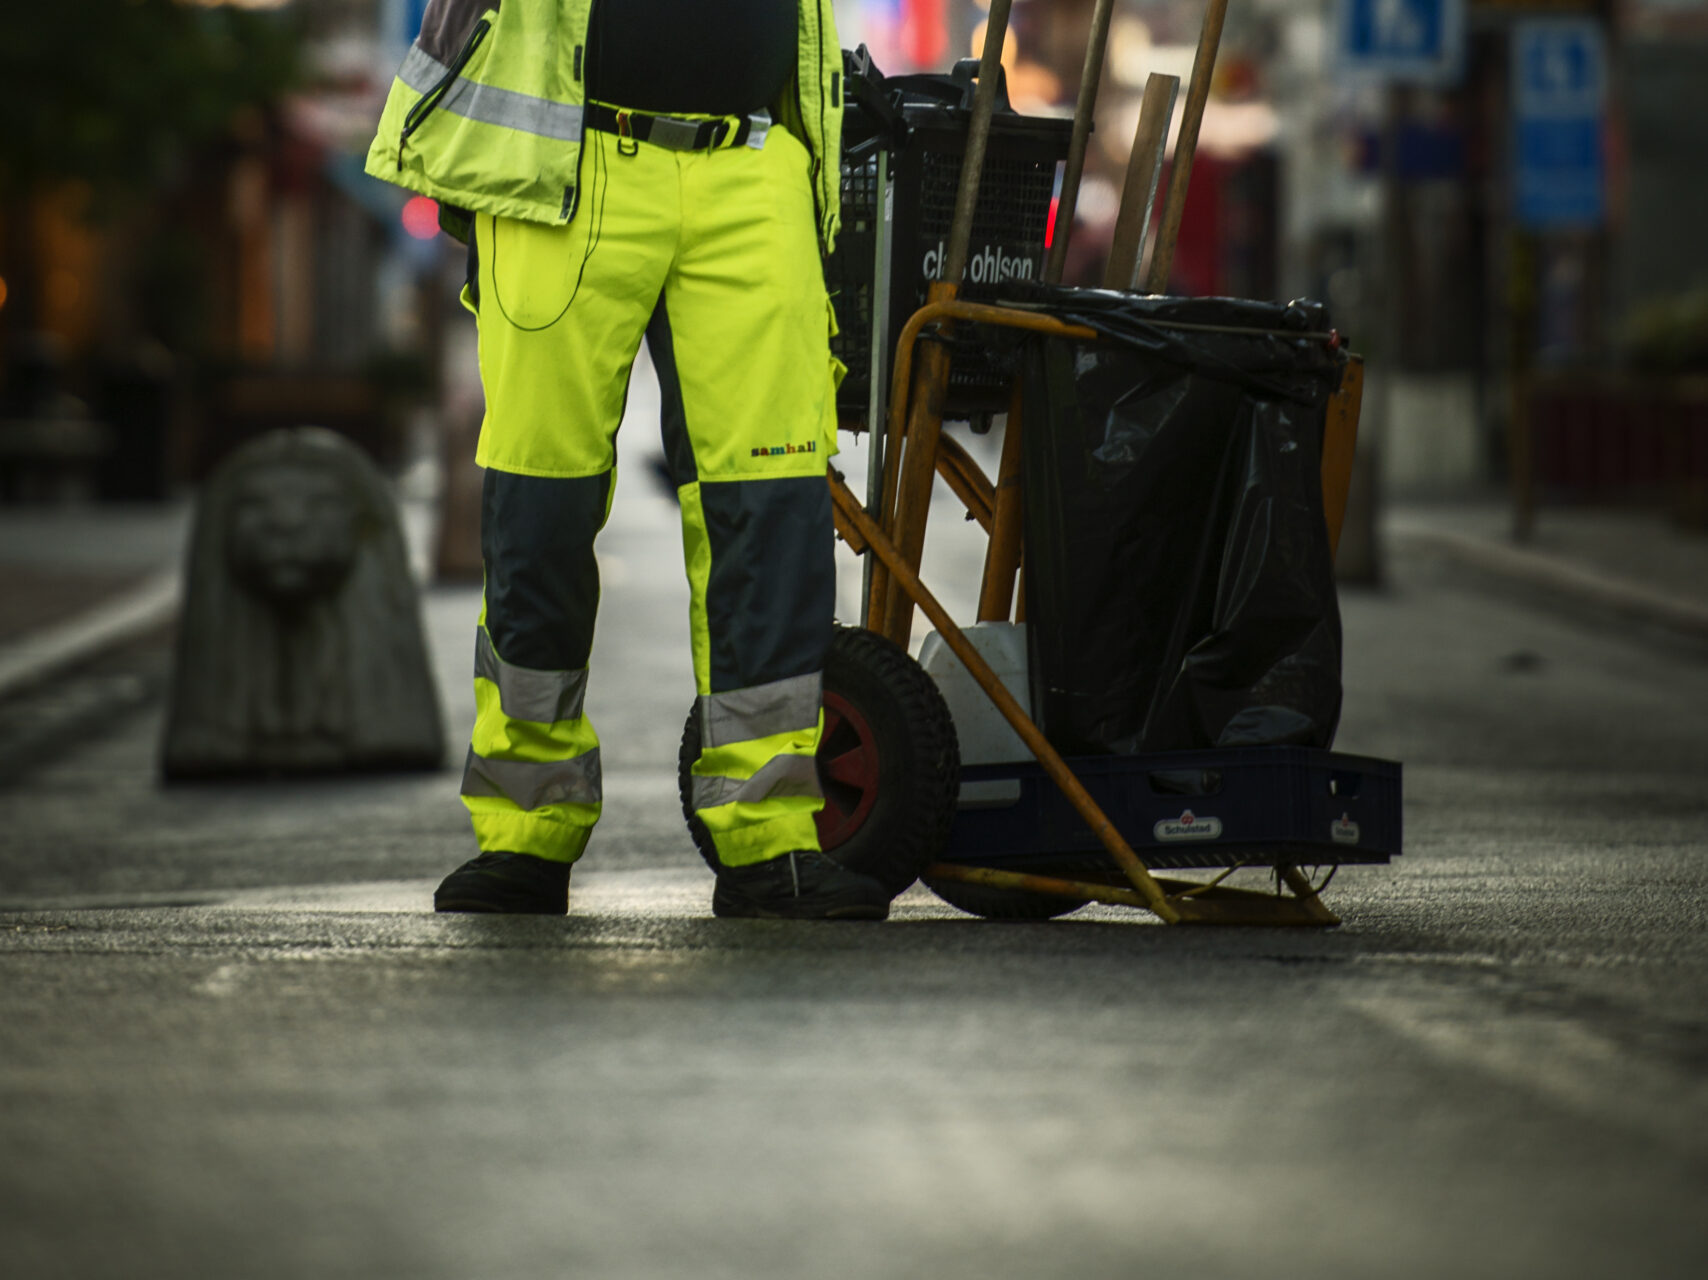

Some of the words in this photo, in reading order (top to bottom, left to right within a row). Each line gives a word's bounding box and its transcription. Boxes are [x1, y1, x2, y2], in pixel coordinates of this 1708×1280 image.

[923, 241, 967, 280] cl
[970, 245, 1033, 284] ohlson
[751, 441, 816, 457] samhall
[1164, 823, 1211, 835] Schulstad
